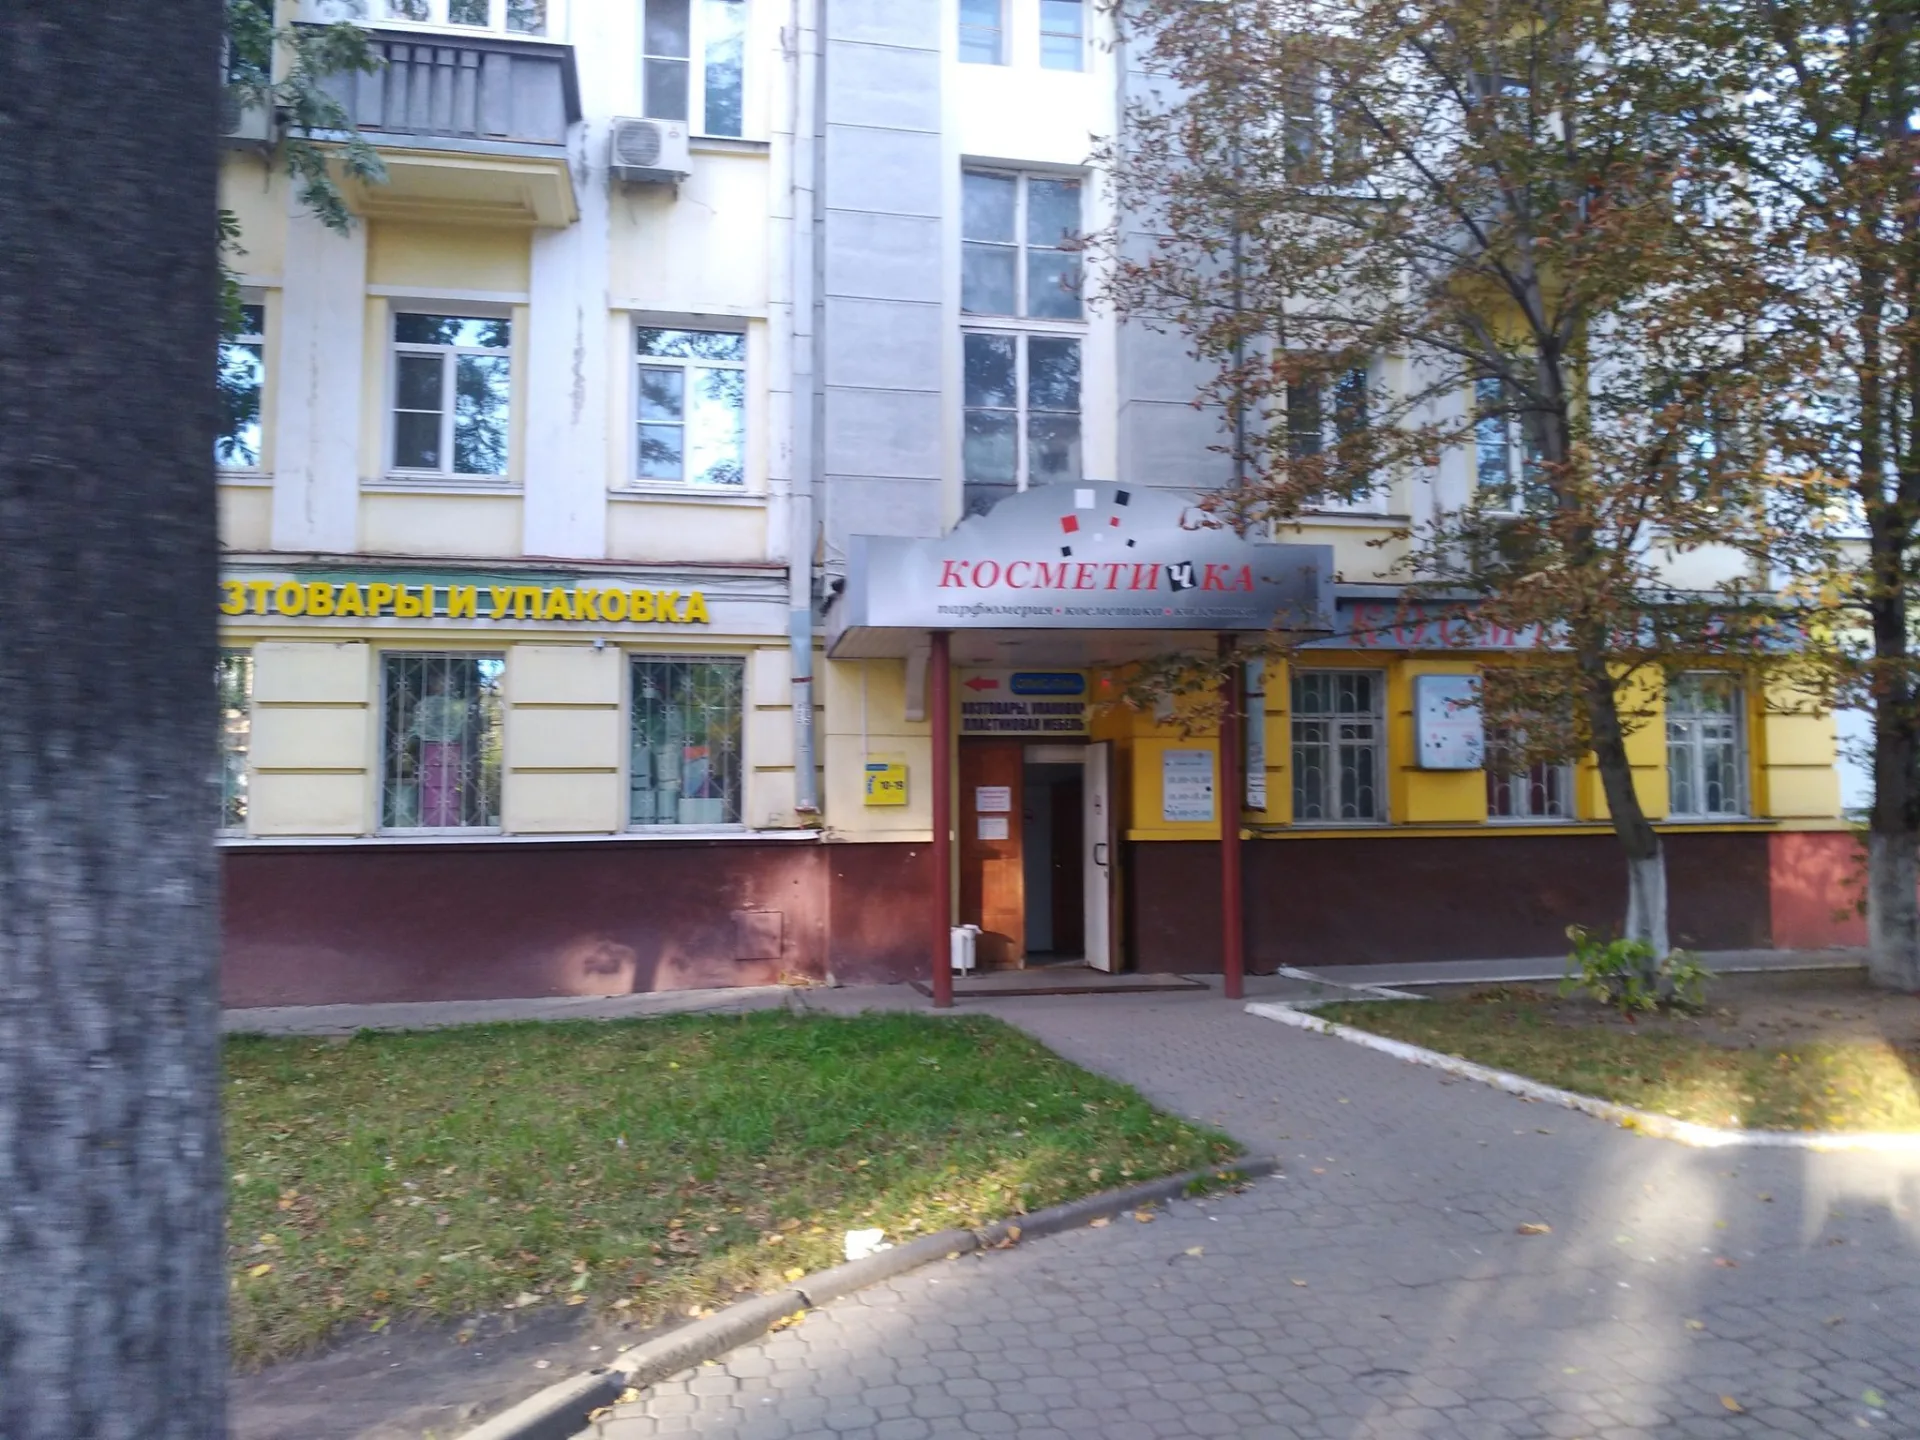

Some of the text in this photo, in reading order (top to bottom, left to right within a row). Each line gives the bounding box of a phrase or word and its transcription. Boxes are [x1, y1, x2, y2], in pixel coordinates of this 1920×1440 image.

[936, 560, 1256, 592] КОСМЕТИЧКА
[447, 584, 478, 619] И
[489, 586, 709, 624] УПАКОВКА
[936, 601, 1054, 618] парфюмерия
